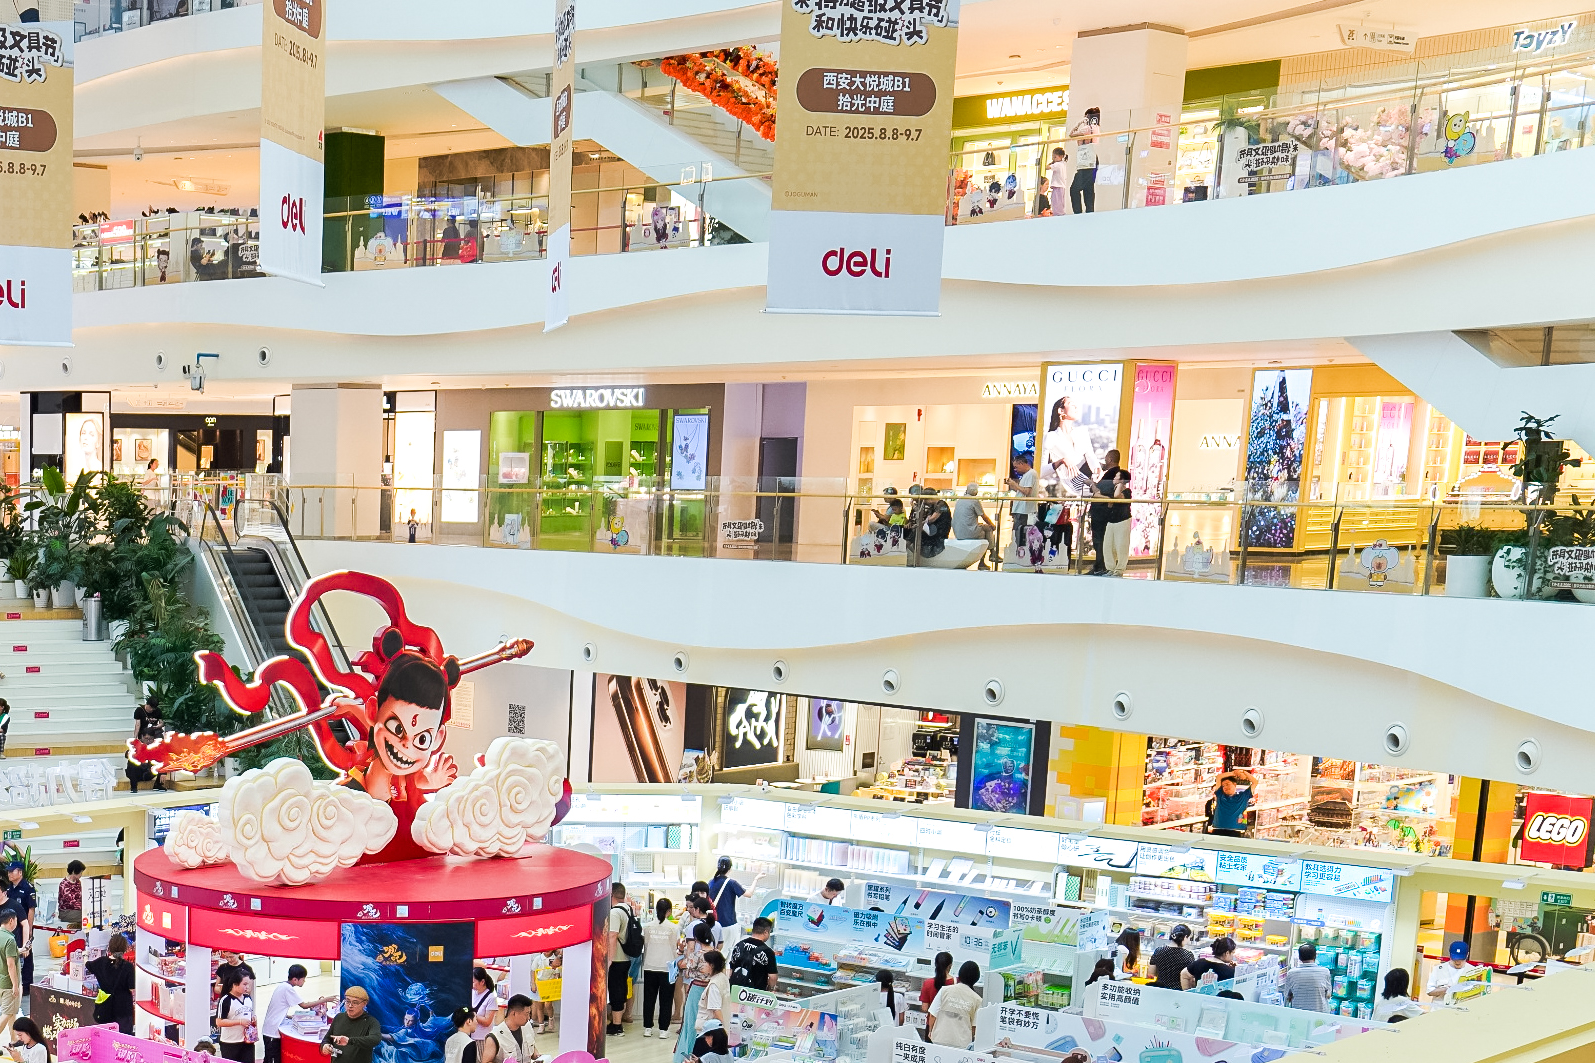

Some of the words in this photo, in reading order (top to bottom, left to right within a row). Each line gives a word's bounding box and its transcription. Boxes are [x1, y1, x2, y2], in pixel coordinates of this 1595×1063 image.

[812, 12, 923, 41] 和快乐碰头
[823, 72, 911, 92] 西安大悦城B1
[837, 93, 895, 112] 拾光中庭
[806, 126, 840, 137] DATE:
[844, 126, 923, 141] 2025.8.8-9.7
[281, 193, 306, 235] deli
[822, 247, 892, 279] deli
[1052, 369, 1117, 383] GUCCI
[1137, 369, 1173, 383] GUCCI
[982, 383, 1038, 397] ANNAYA
[550, 388, 645, 408] SWAROVSKI
[675, 416, 708, 424] SWAROVSKI
[1530, 811, 1587, 846] LEGO
[927, 922, 959, 934] 学习生活的
[927, 930, 952, 940] 时间管家
[1101, 983, 1141, 997] 多功能收纳
[1100, 992, 1140, 1006] 实用高颜值
[1000, 1006, 1040, 1021] 开学不要慌
[999, 1016, 1039, 1030] 笔袋有妙方
[895, 1041, 927, 1055] 纯白有度
